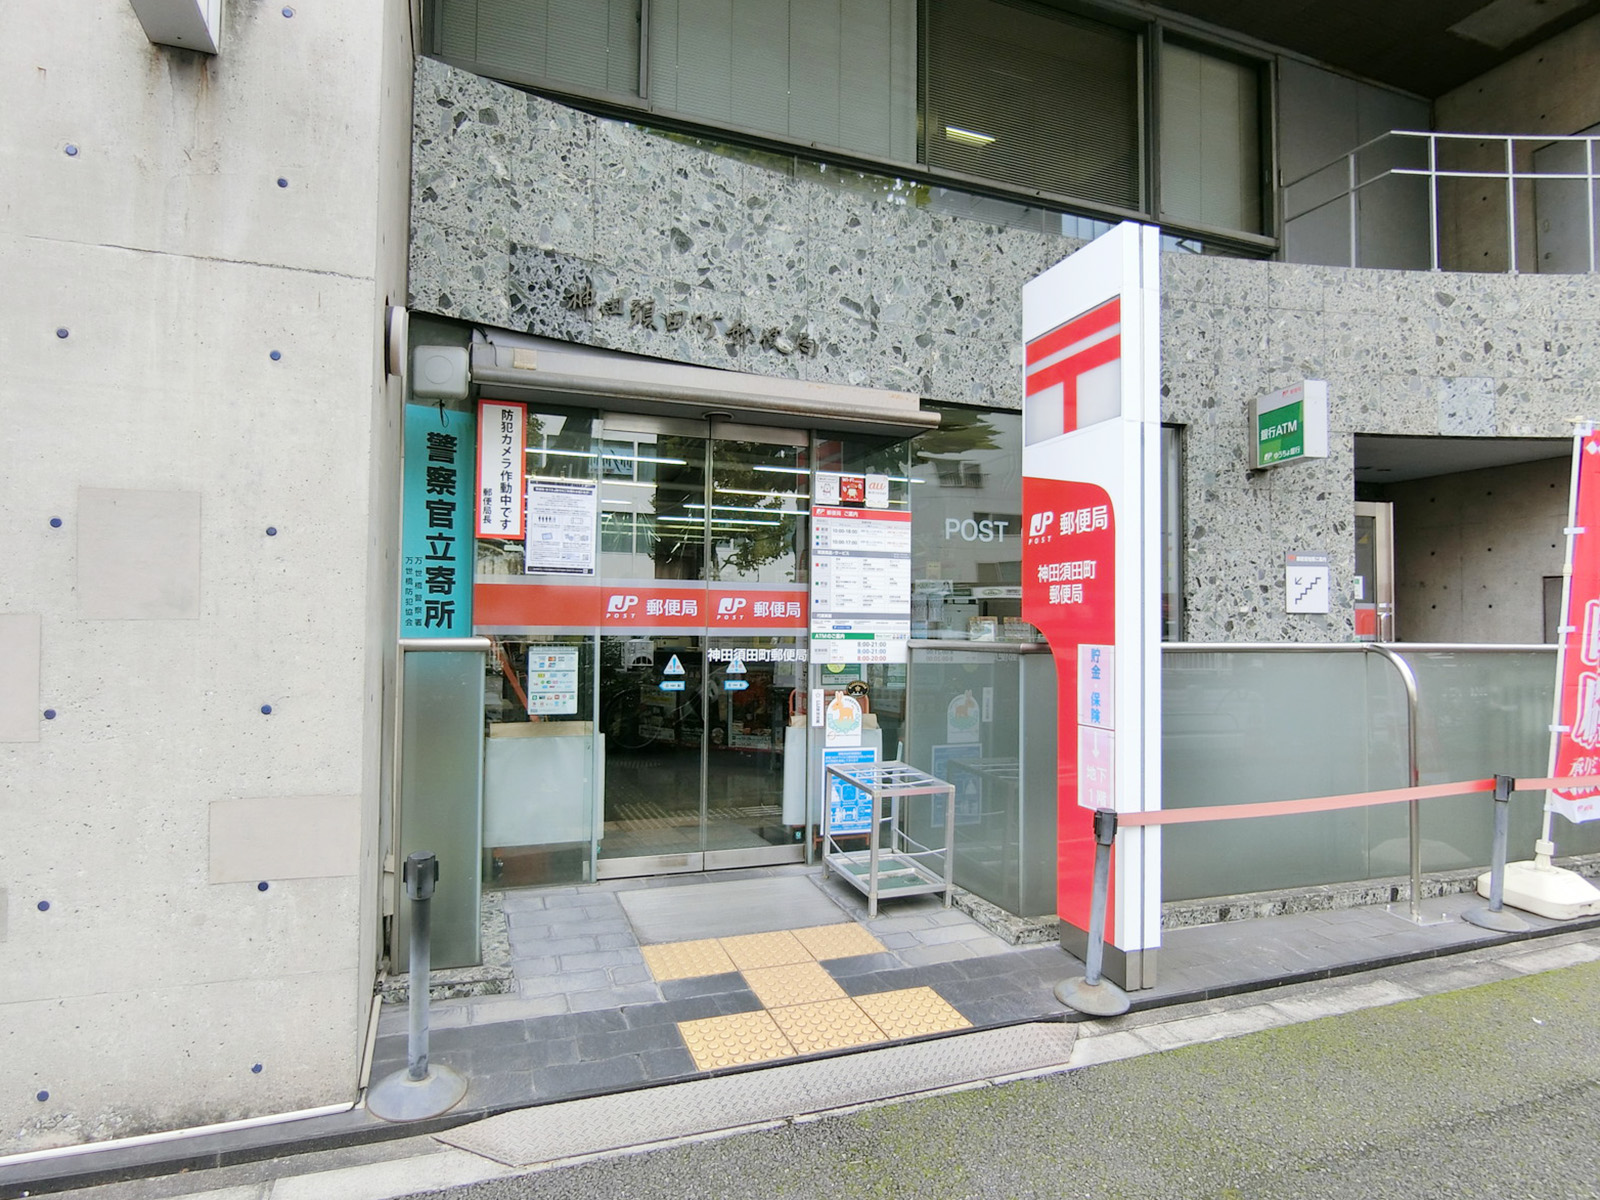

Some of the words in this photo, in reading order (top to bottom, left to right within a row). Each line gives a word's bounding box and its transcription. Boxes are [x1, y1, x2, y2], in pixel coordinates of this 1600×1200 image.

[1260, 419, 1298, 441] 銀行ATM
[500, 408, 514, 531] 防犯カメラ作動中です
[868, 483, 886, 491] au
[482, 487, 493, 525] 郵便局長
[425, 431, 458, 630] 警察官立寄所
[945, 518, 1009, 543] POST
[1059, 505, 1108, 536] 郵便局
[1028, 534, 1052, 546] POST
[1037, 560, 1097, 584] 神田須田町
[405, 556, 414, 627] 万世橋防犯協会
[414, 556, 423, 627] 万世橋警察署
[1049, 583, 1083, 605] 郵便局
[646, 599, 698, 617] 郵便局
[753, 601, 801, 618] 郵便局
[707, 647, 808, 662] 神田須田町郵便局
